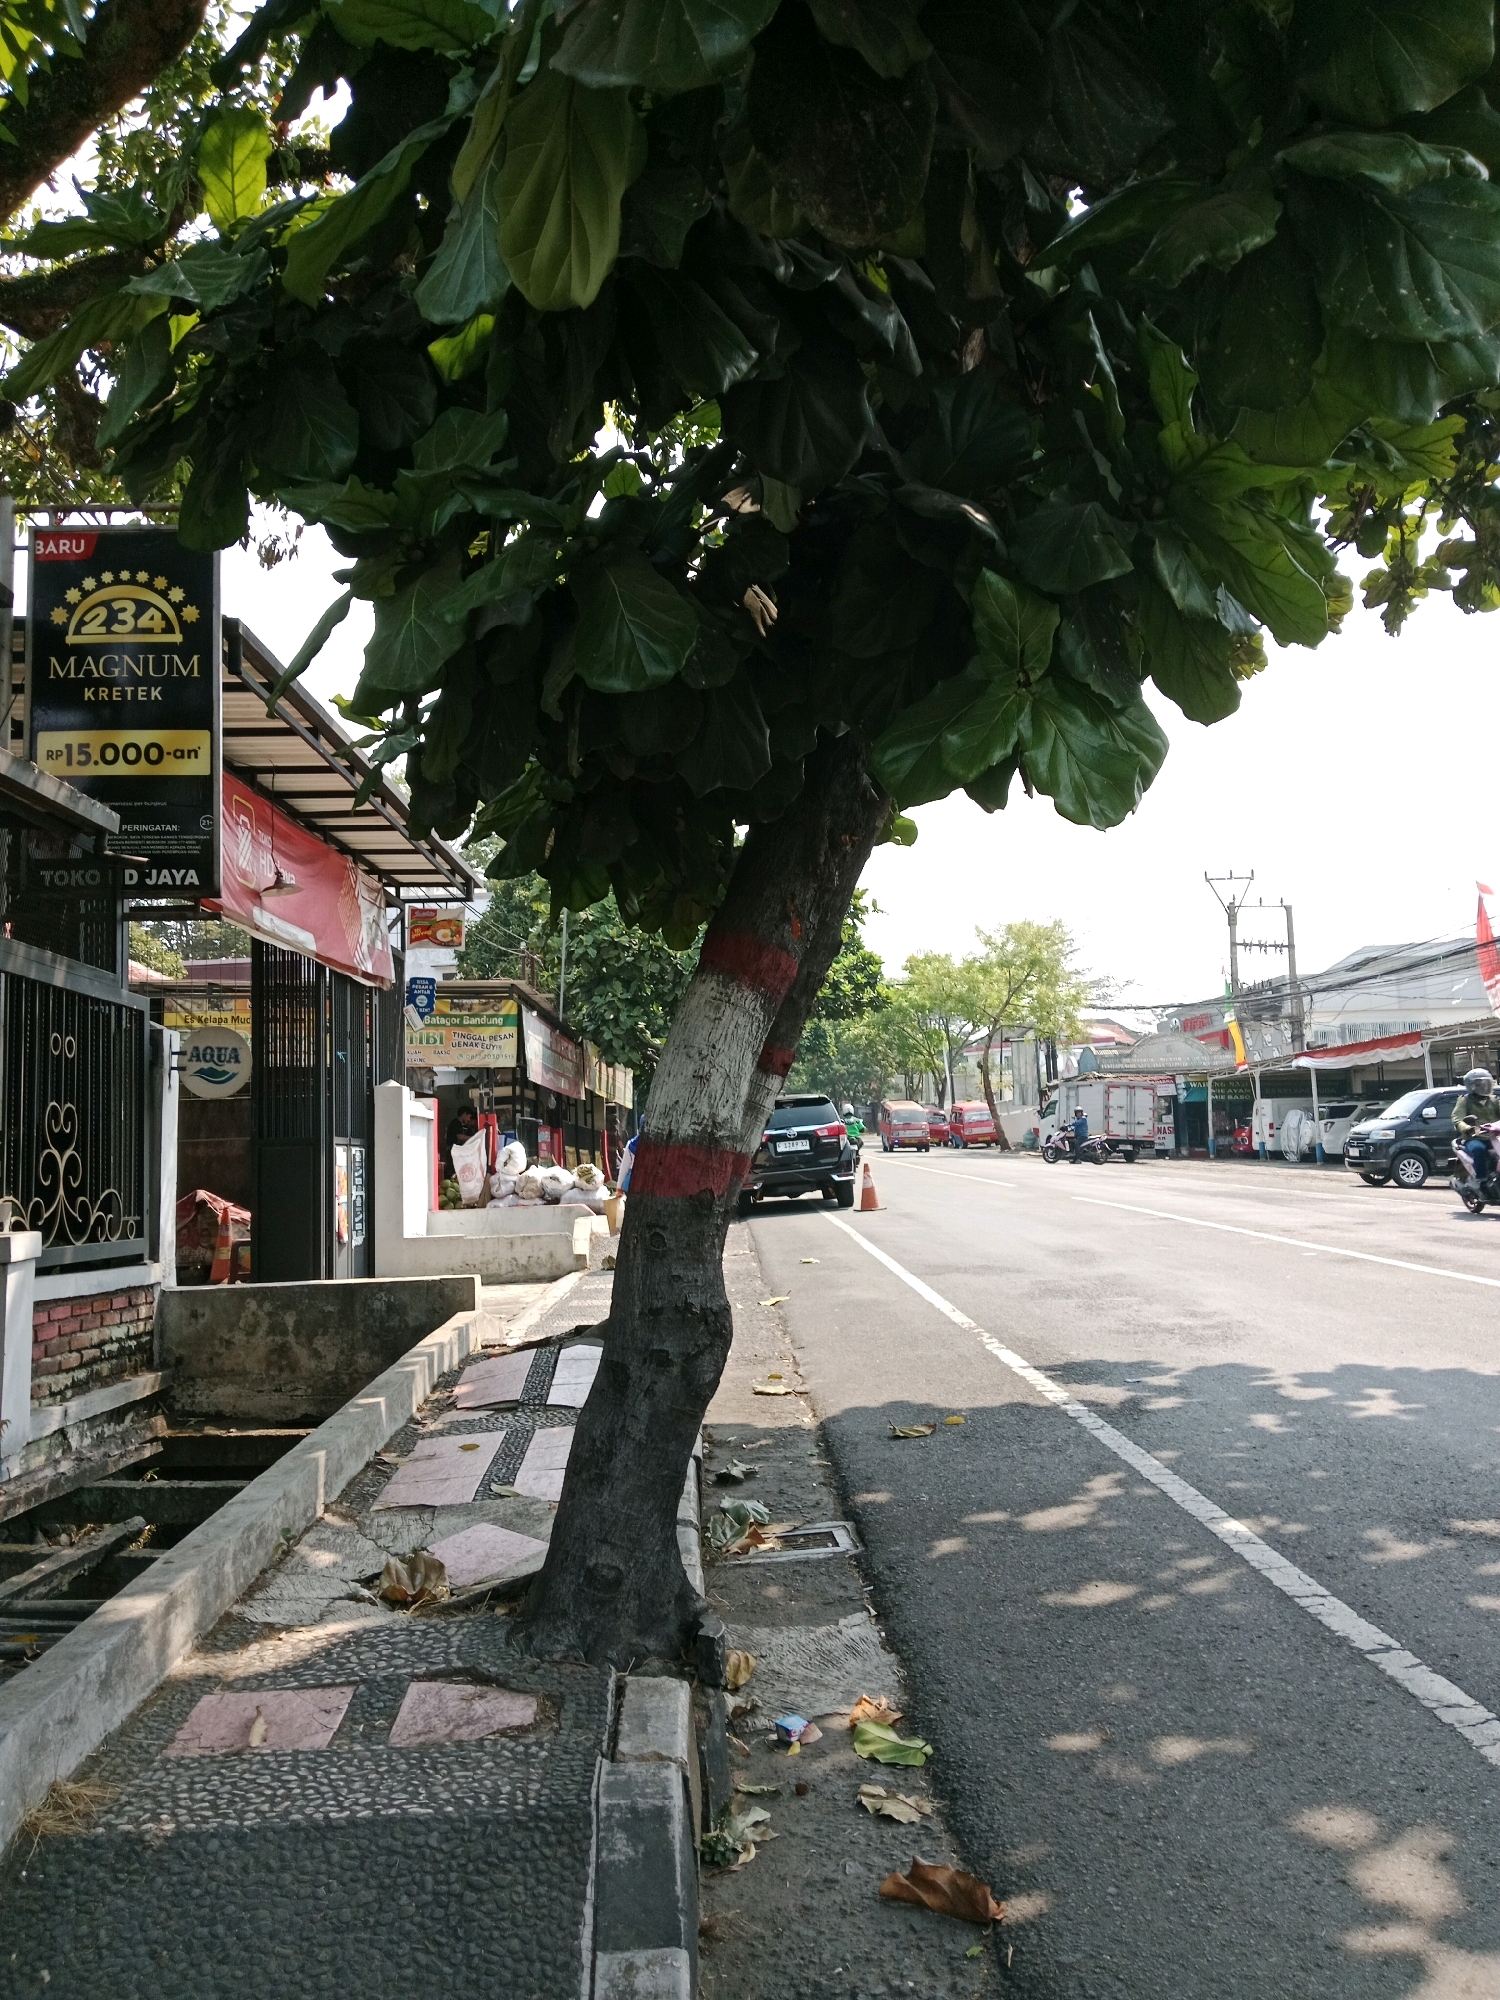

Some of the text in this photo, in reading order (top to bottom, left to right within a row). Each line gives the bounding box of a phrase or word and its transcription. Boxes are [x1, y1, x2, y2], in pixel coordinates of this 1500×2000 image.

[35, 539, 85, 555] BARU
[81, 600, 166, 634] 234
[49, 654, 201, 679] MAGNUM
[84, 686, 163, 701] KRETEK
[121, 824, 180, 832] PERINGATAN:
[40, 869, 101, 887] TOKO
[145, 868, 200, 886] JAYA
[184, 1014, 195, 1024] Es
[197, 1015, 228, 1025] Kelapa
[425, 1016, 461, 1026] Batagor
[463, 1015, 504, 1027] Bandung
[452, 1031, 515, 1043] TINGGAL PESAN
[451, 1041, 480, 1049] UENAK
[187, 1045, 242, 1066] AQUA
